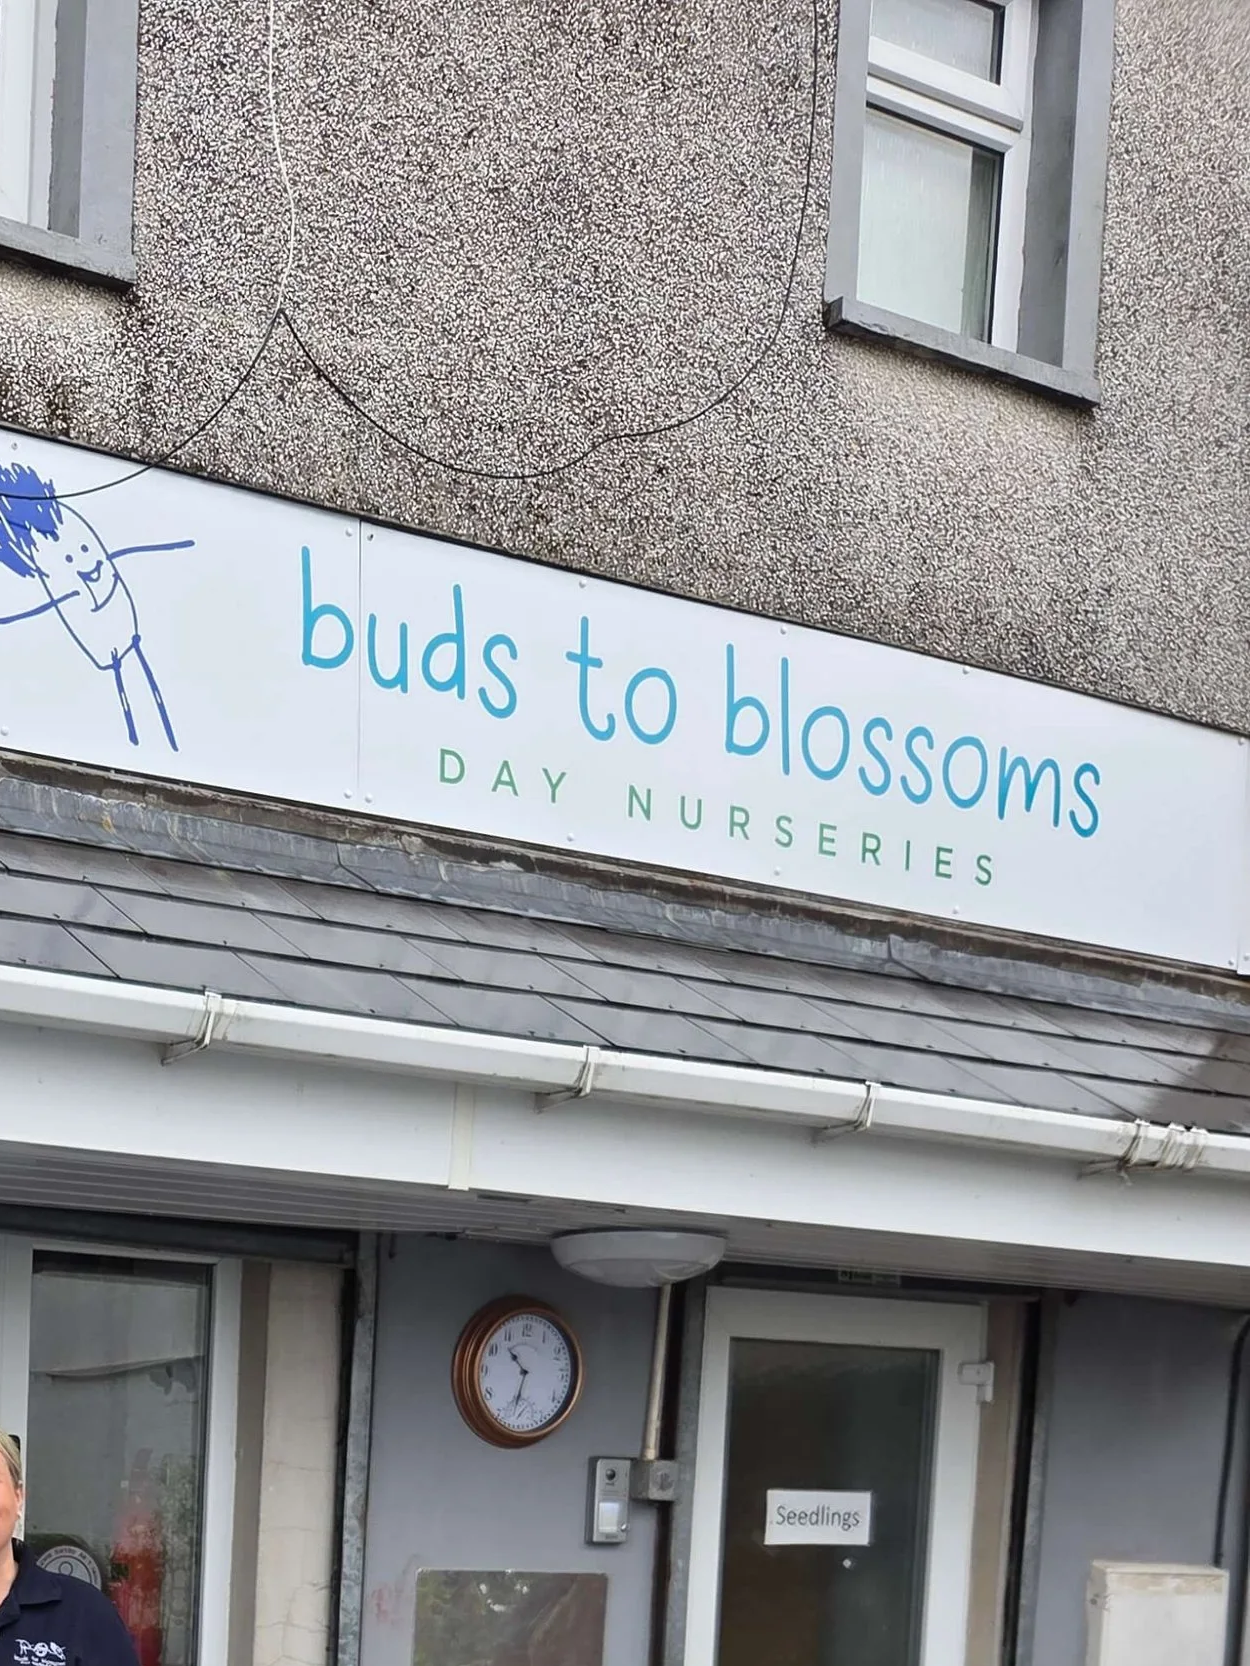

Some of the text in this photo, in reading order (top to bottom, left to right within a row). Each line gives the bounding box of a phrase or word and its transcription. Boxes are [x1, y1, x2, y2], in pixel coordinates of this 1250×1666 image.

[301, 546, 1102, 839] buds to blossoms
[439, 747, 994, 887] DAY NURSERIES
[775, 1504, 861, 1531] Seedlings
